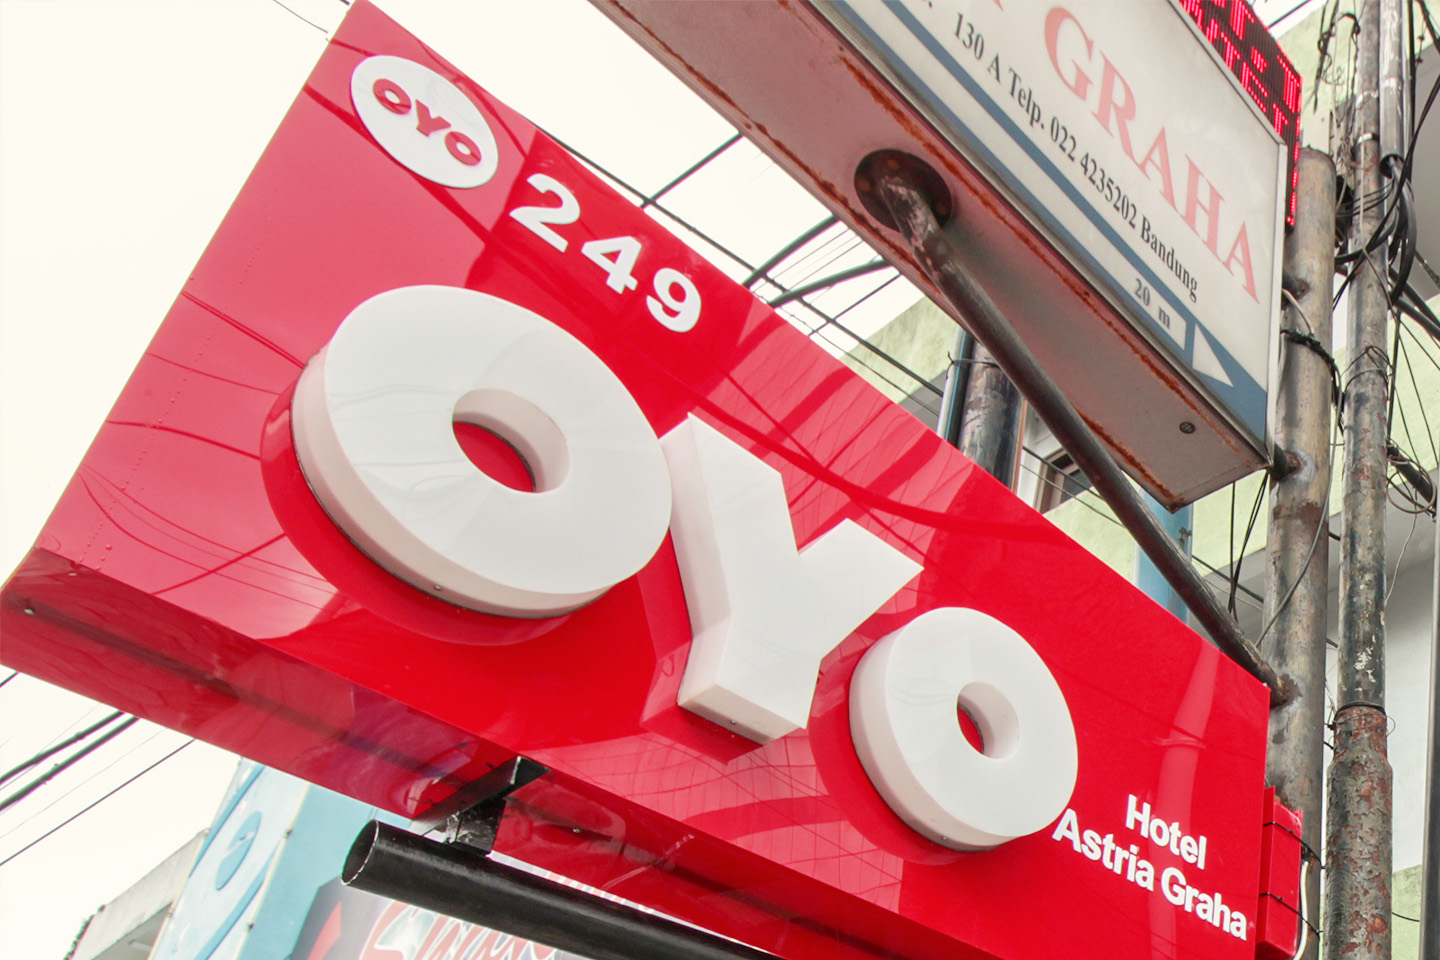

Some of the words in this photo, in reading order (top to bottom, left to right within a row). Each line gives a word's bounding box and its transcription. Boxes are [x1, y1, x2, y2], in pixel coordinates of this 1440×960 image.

[372, 78, 483, 167] OYO
[508, 172, 702, 334] 249
[954, 12, 985, 61] 130
[987, 53, 1002, 85] A
[1008, 66, 1045, 130] Telp.
[1050, 116, 1077, 162] 022
[1080, 151, 1138, 230] 4235202
[1140, 213, 1198, 303] Bandung
[1044, 6, 1260, 304] GRAHA
[1134, 278, 1151, 307] 20
[1158, 306, 1171, 330] m
[291, 284, 1079, 852] OYO
[1051, 808, 1155, 892] Astria
[1160, 866, 1248, 942] Graha
[1125, 793, 1208, 870] Hotel
